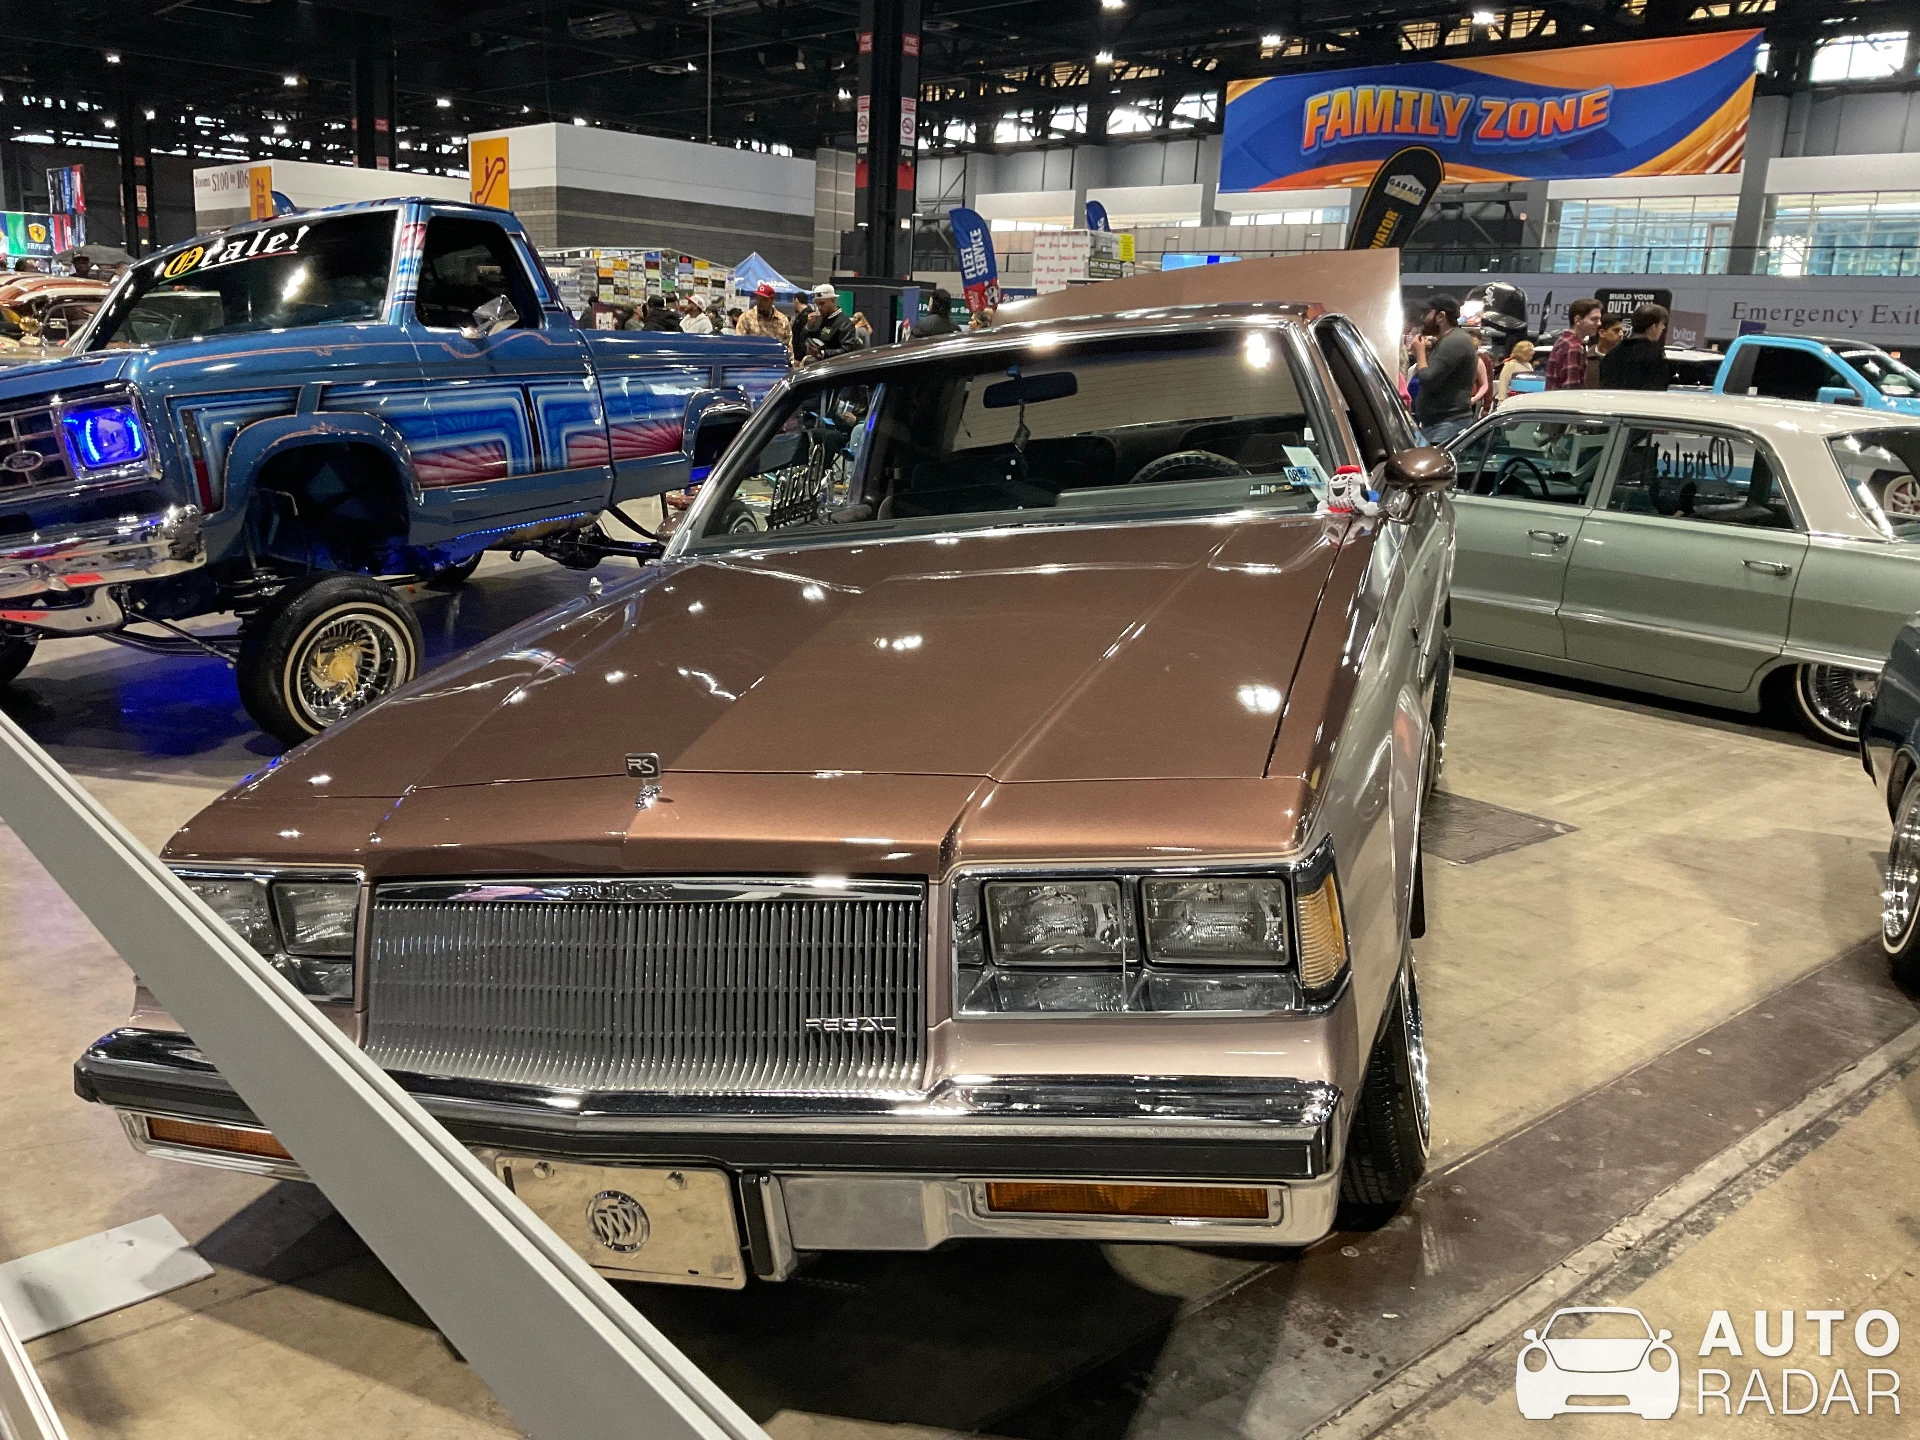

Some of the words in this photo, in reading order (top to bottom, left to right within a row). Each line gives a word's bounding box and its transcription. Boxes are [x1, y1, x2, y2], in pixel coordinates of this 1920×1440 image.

[1302, 87, 1473, 151] FAMILY
[1476, 87, 1612, 140] ZONE
[1388, 178, 1425, 197] GARAGE
[960, 247, 977, 280] FLEET
[969, 228, 989, 276] SERVICE
[1730, 301, 1863, 328] Emergency
[1870, 304, 1920, 325] Exit
[627, 758, 655, 774] RS
[805, 1016, 897, 1033] REGAL
